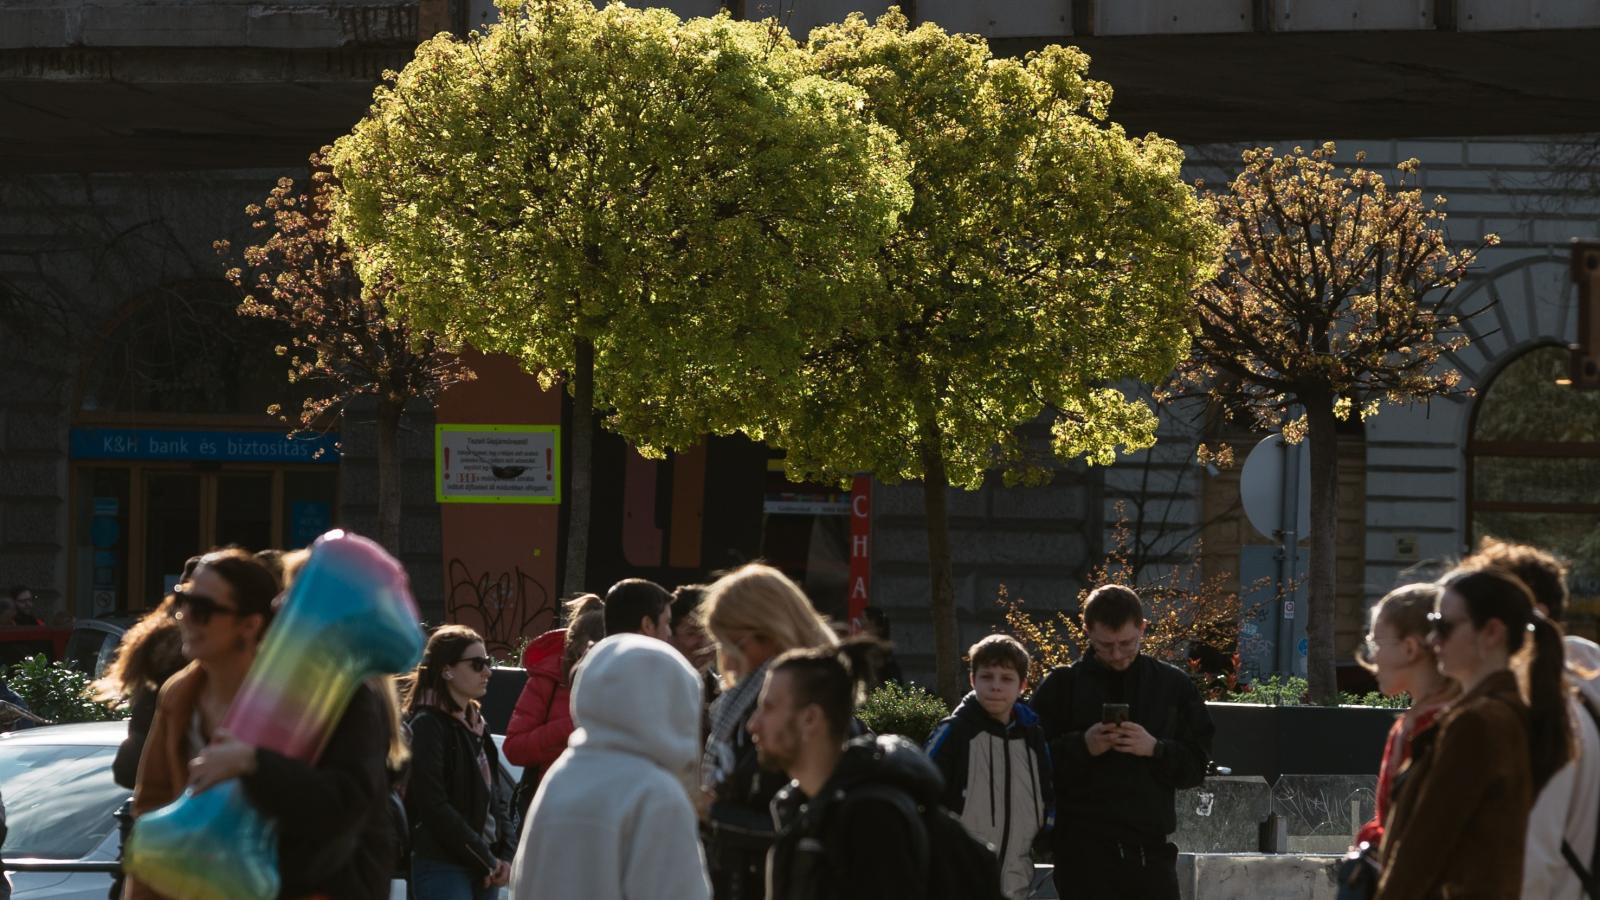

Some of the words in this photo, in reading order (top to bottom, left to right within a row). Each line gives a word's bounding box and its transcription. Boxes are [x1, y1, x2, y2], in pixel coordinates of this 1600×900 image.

[103, 436, 137, 454] K&H
[149, 436, 189, 455] bank
[200, 437, 217, 456] és
[227, 438, 309, 458] biztosítás
